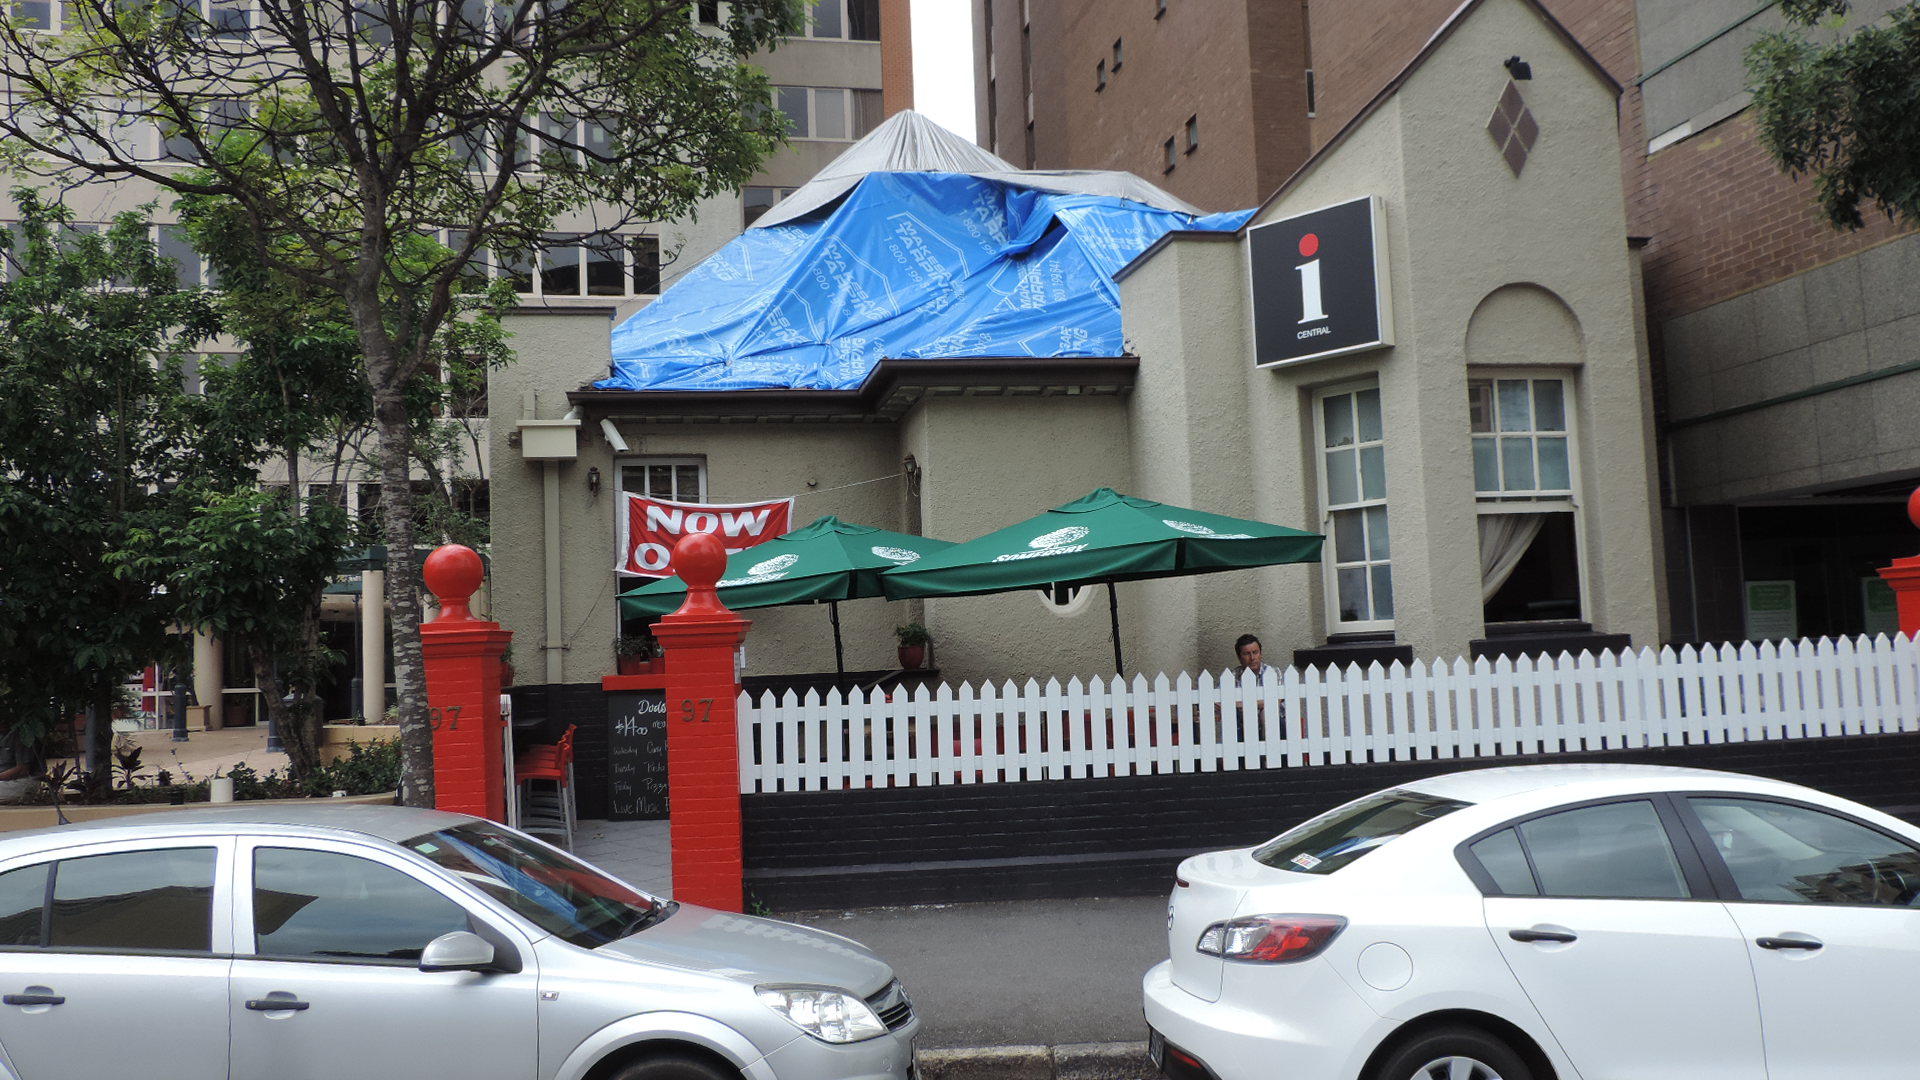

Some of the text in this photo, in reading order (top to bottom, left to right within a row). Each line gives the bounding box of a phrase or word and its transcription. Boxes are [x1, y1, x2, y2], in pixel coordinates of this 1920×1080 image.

[889, 244, 907, 263] 800
[813, 267, 831, 290] 800
[1294, 233, 1329, 324] i
[1297, 325, 1332, 340] CENTRAL
[646, 506, 771, 537] NOW
[428, 706, 462, 730] 97
[681, 698, 714, 723] 97
